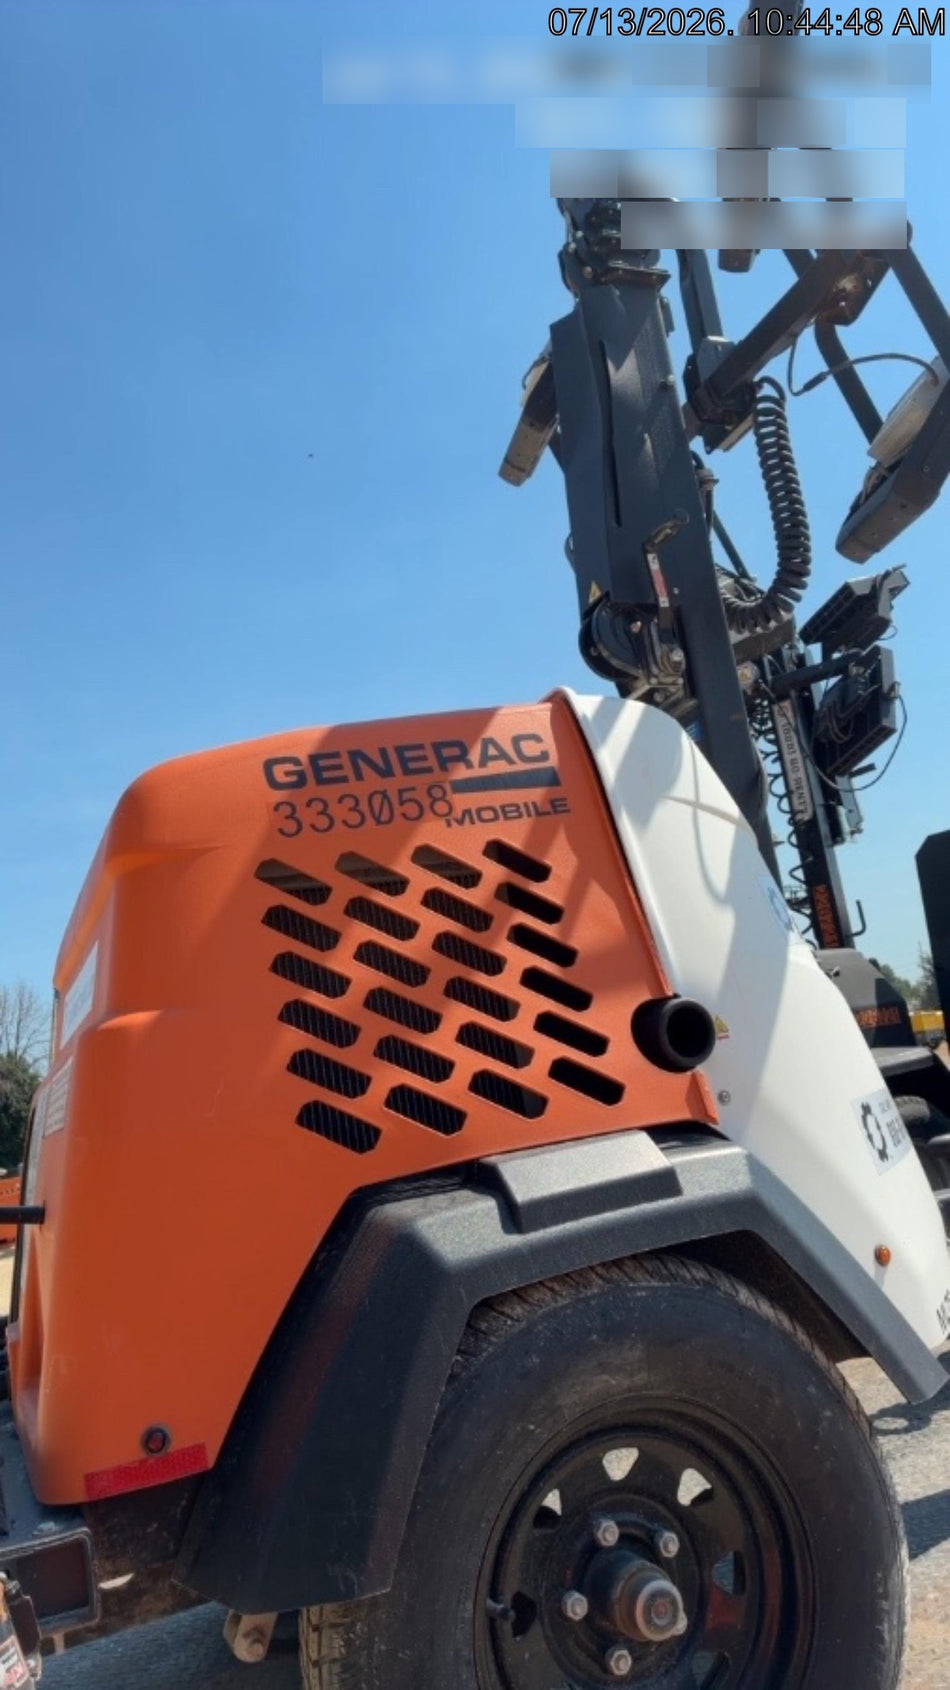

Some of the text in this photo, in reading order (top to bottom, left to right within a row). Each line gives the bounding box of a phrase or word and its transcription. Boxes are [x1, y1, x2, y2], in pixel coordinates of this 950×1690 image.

[262, 733, 551, 790] GENERAC
[273, 783, 454, 838] 333058
[445, 797, 572, 827] MOBILE
